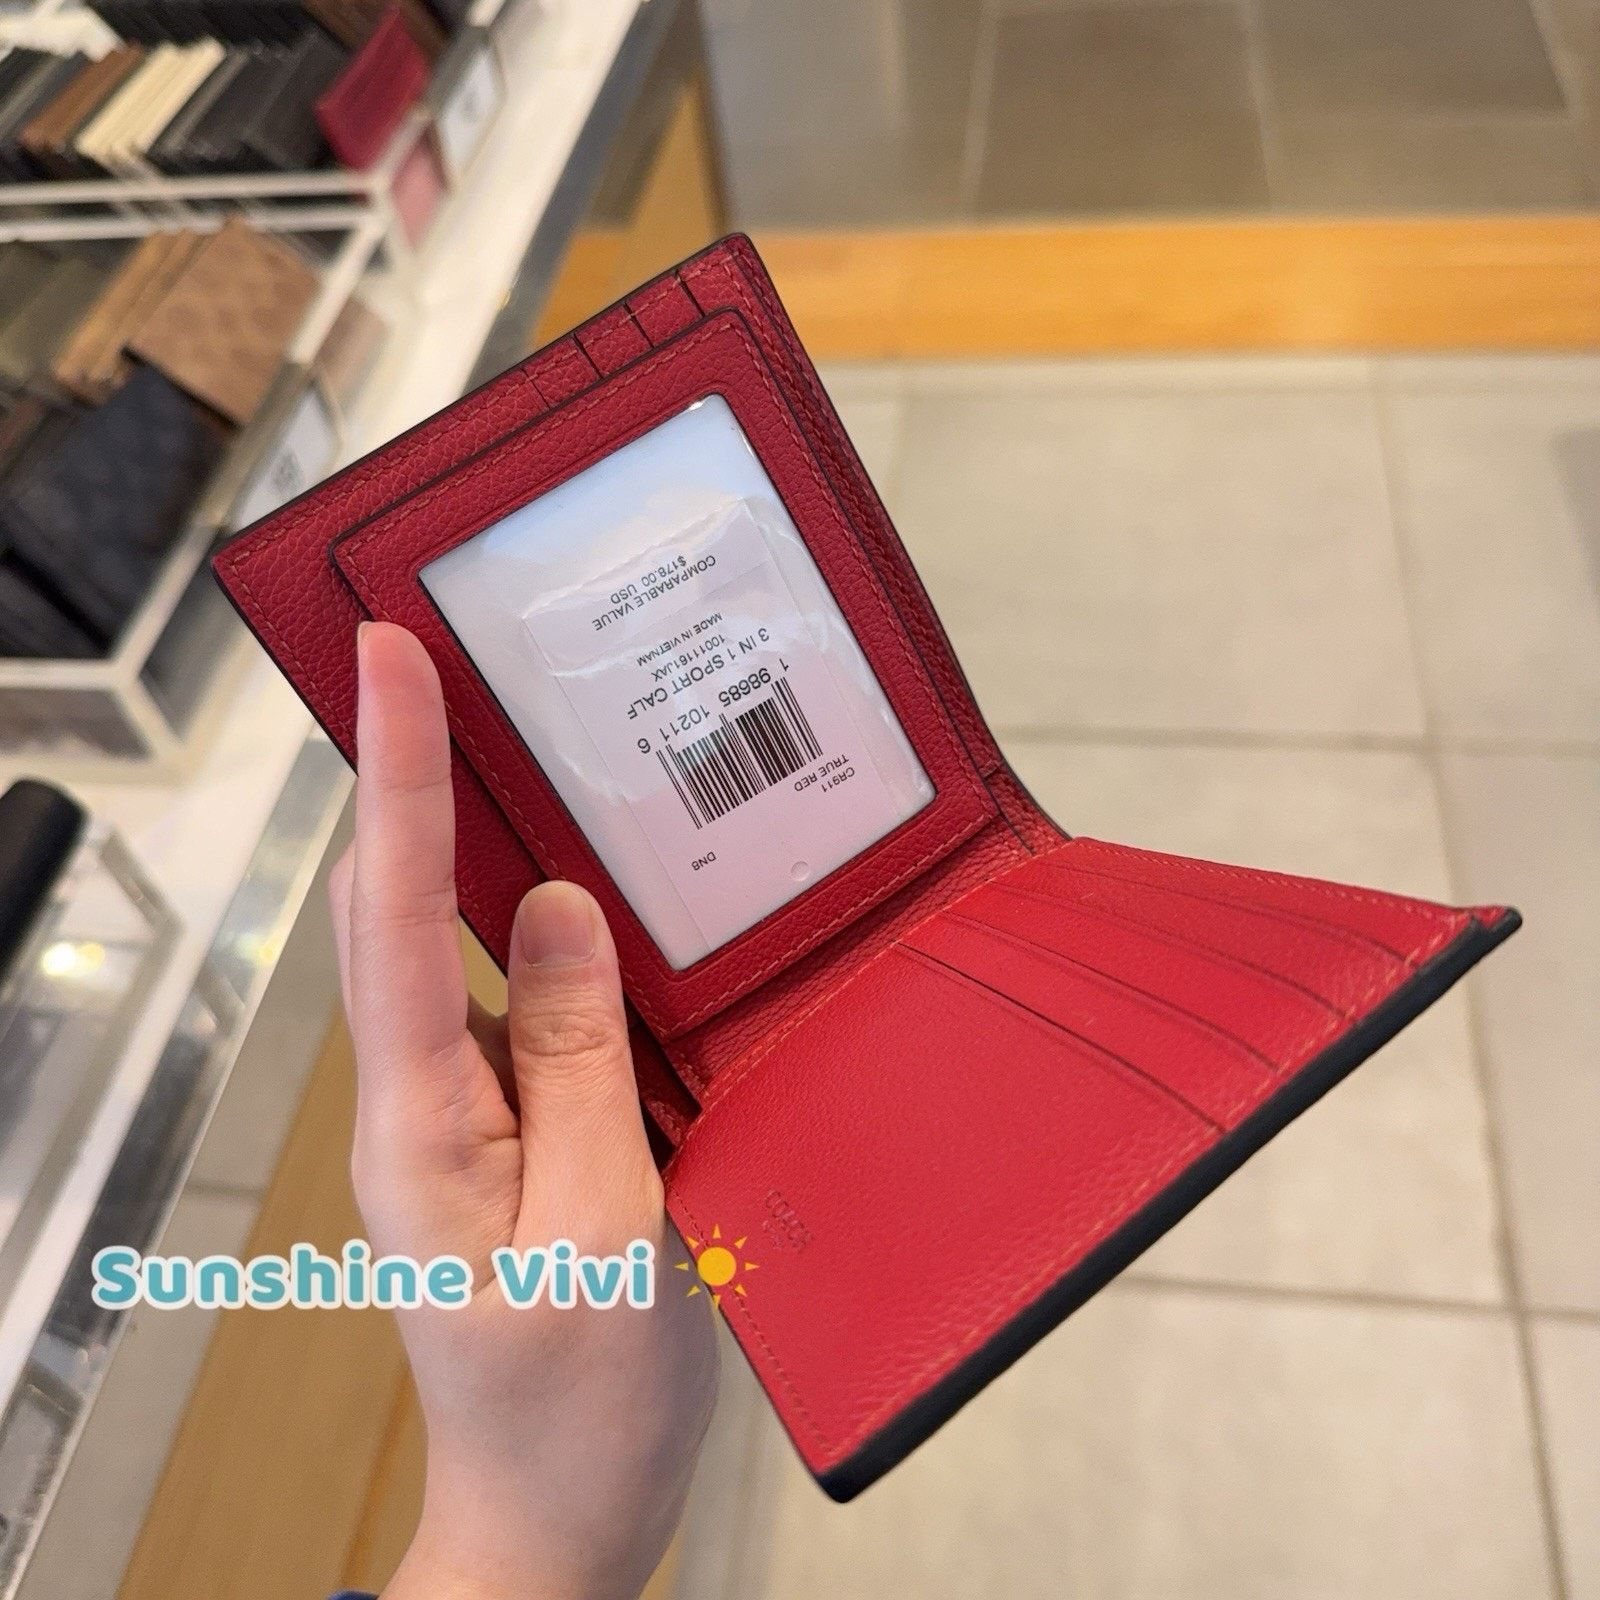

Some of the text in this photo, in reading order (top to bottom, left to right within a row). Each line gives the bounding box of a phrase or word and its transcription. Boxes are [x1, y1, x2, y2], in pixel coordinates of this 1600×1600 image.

[591, 555, 716, 631] COMPARABLE VALUE
[610, 555, 687, 604] $178.00 USD
[636, 612, 723, 667] MADE IN VIETNAM
[651, 634, 726, 682] 10011161JAX
[626, 627, 770, 720] 3 IN 1 SPORT CALF
[637, 658, 789, 754] 1 98685 10211 6
[794, 754, 850, 792] TRUE RED
[820, 766, 856, 793] CR911
[691, 851, 717, 871] DN8
